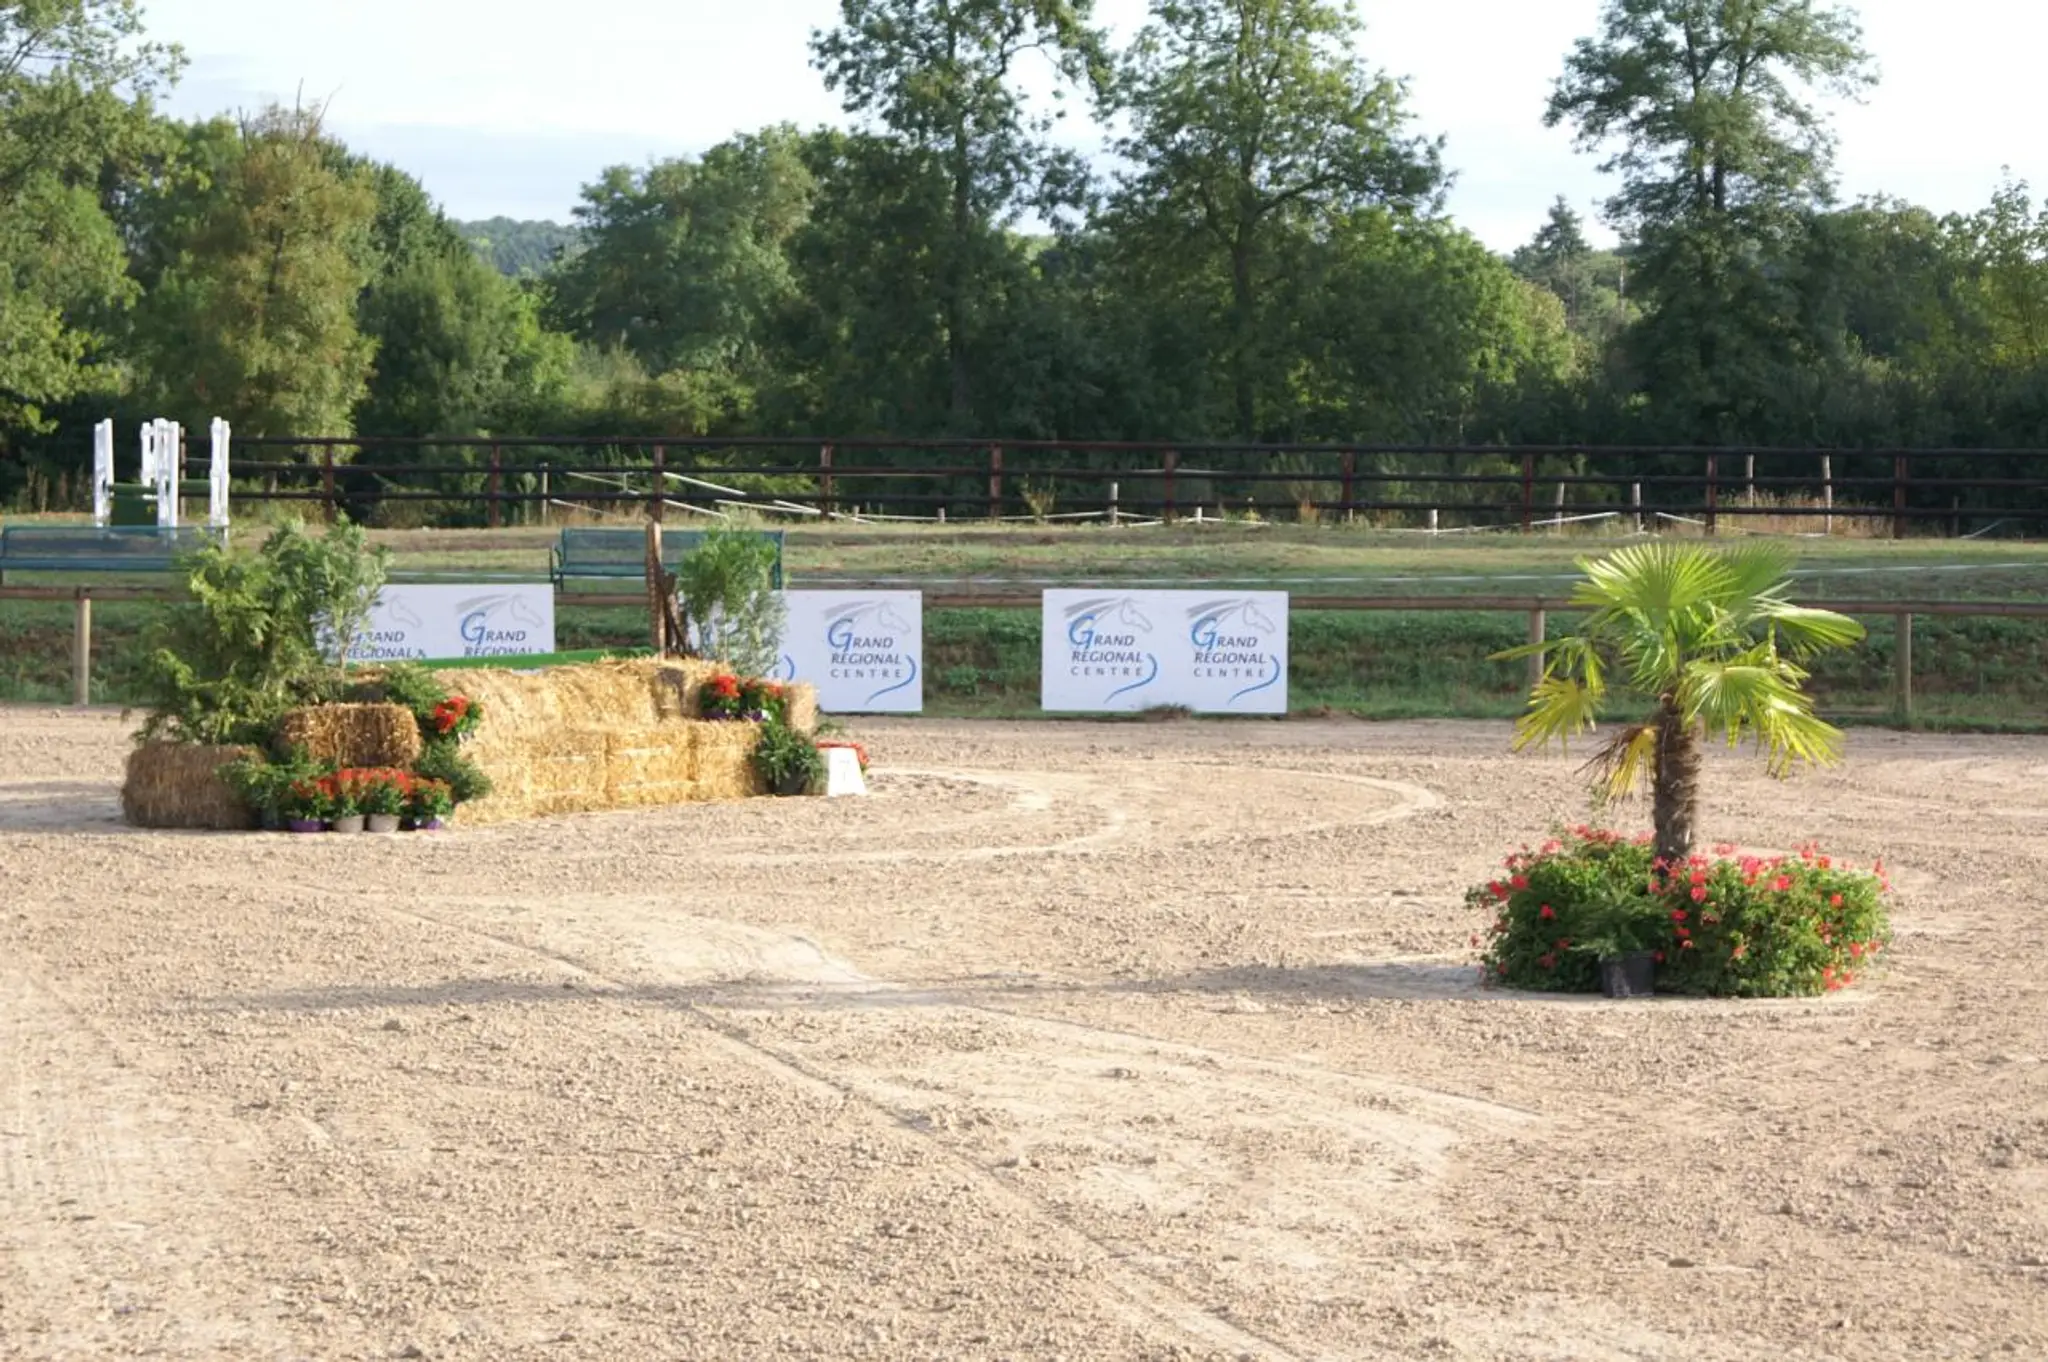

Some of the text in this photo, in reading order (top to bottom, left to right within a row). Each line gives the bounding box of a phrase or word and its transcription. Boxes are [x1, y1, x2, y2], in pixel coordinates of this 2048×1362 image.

[461, 612, 526, 645] GRAND
[1069, 614, 1135, 650] GRAND
[1191, 616, 1258, 650] GRAND
[828, 618, 894, 652] GRAND
[831, 652, 902, 665] REGIONAL
[1072, 651, 1143, 663] REGIONAL
[1194, 652, 1267, 664] REGIONAL
[830, 668, 902, 678] CENTRE
[1071, 666, 1142, 676] CENTRE
[1193, 667, 1265, 677] CENTRE
